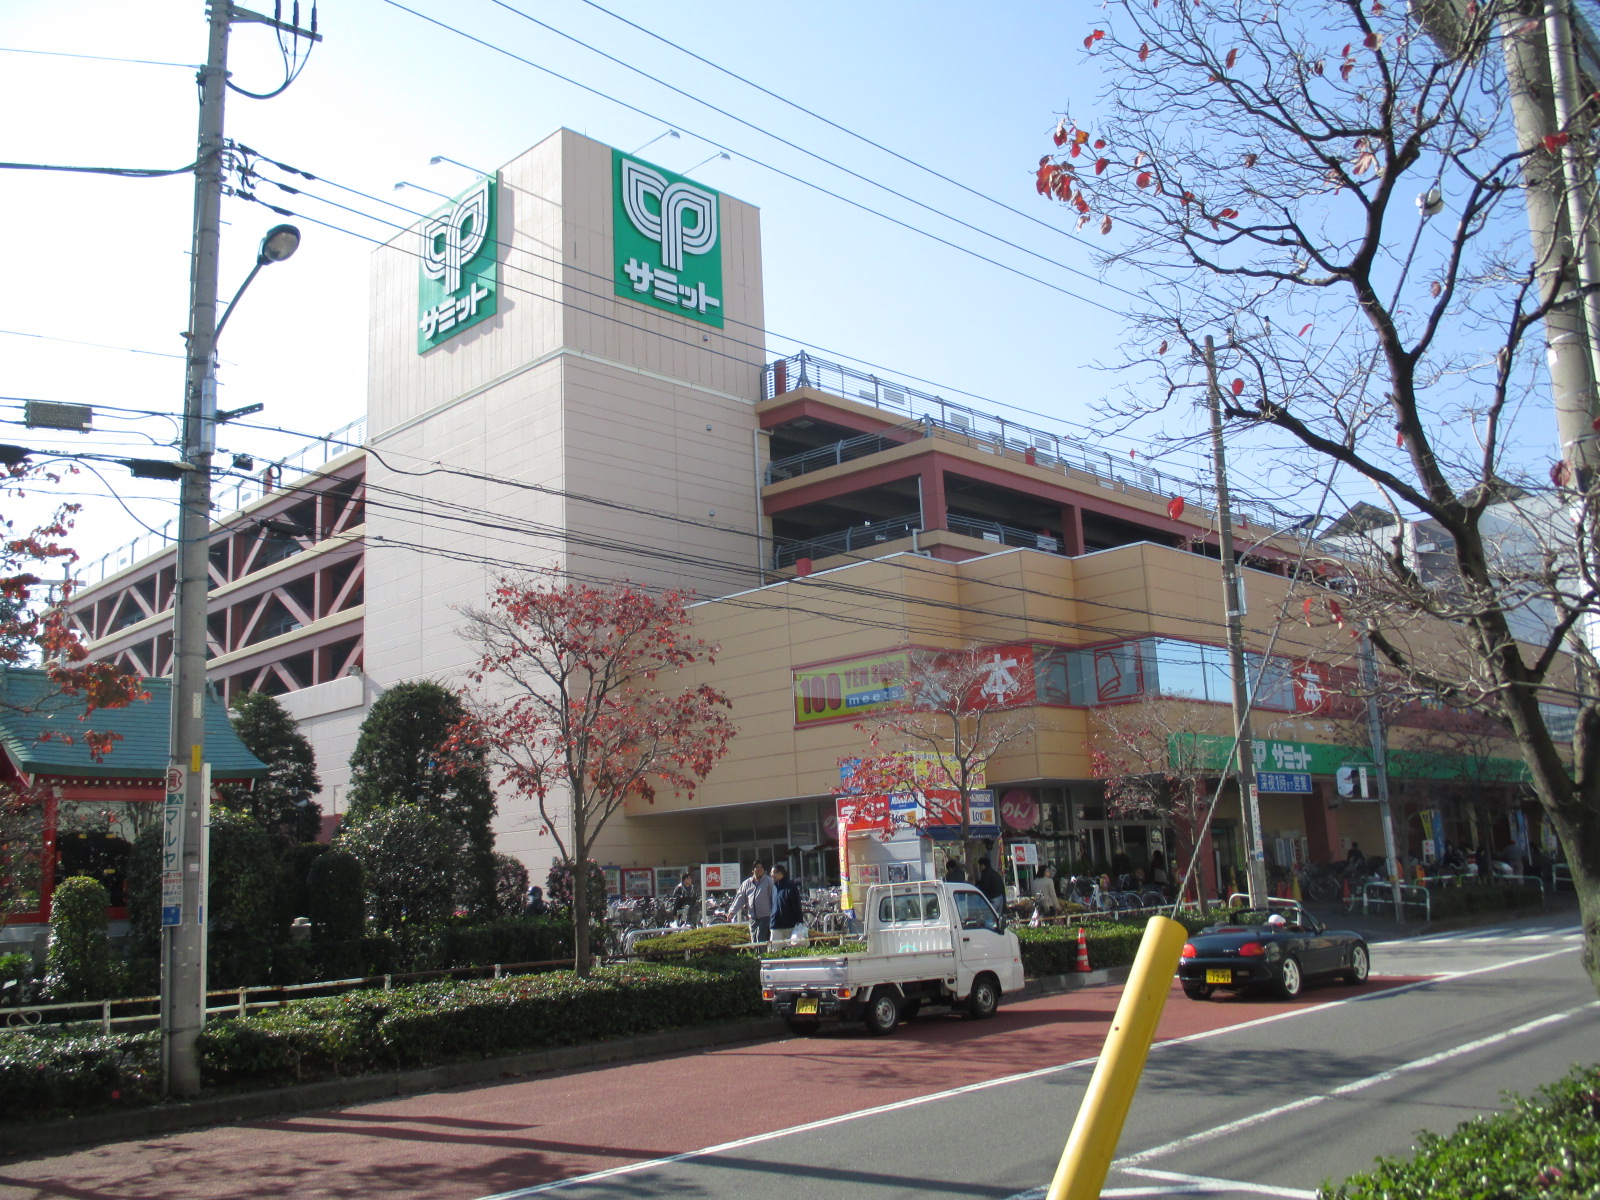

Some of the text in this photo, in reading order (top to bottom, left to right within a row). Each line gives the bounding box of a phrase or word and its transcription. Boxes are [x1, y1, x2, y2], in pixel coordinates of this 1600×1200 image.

[624, 257, 720, 314] サミット
[419, 282, 488, 341] サミット
[800, 673, 842, 714] 100
[844, 667, 869, 688] YEN
[979, 653, 1021, 703] 本
[1271, 743, 1313, 771] サミット
[1260, 774, 1308, 791] 深夜1時まで営業
